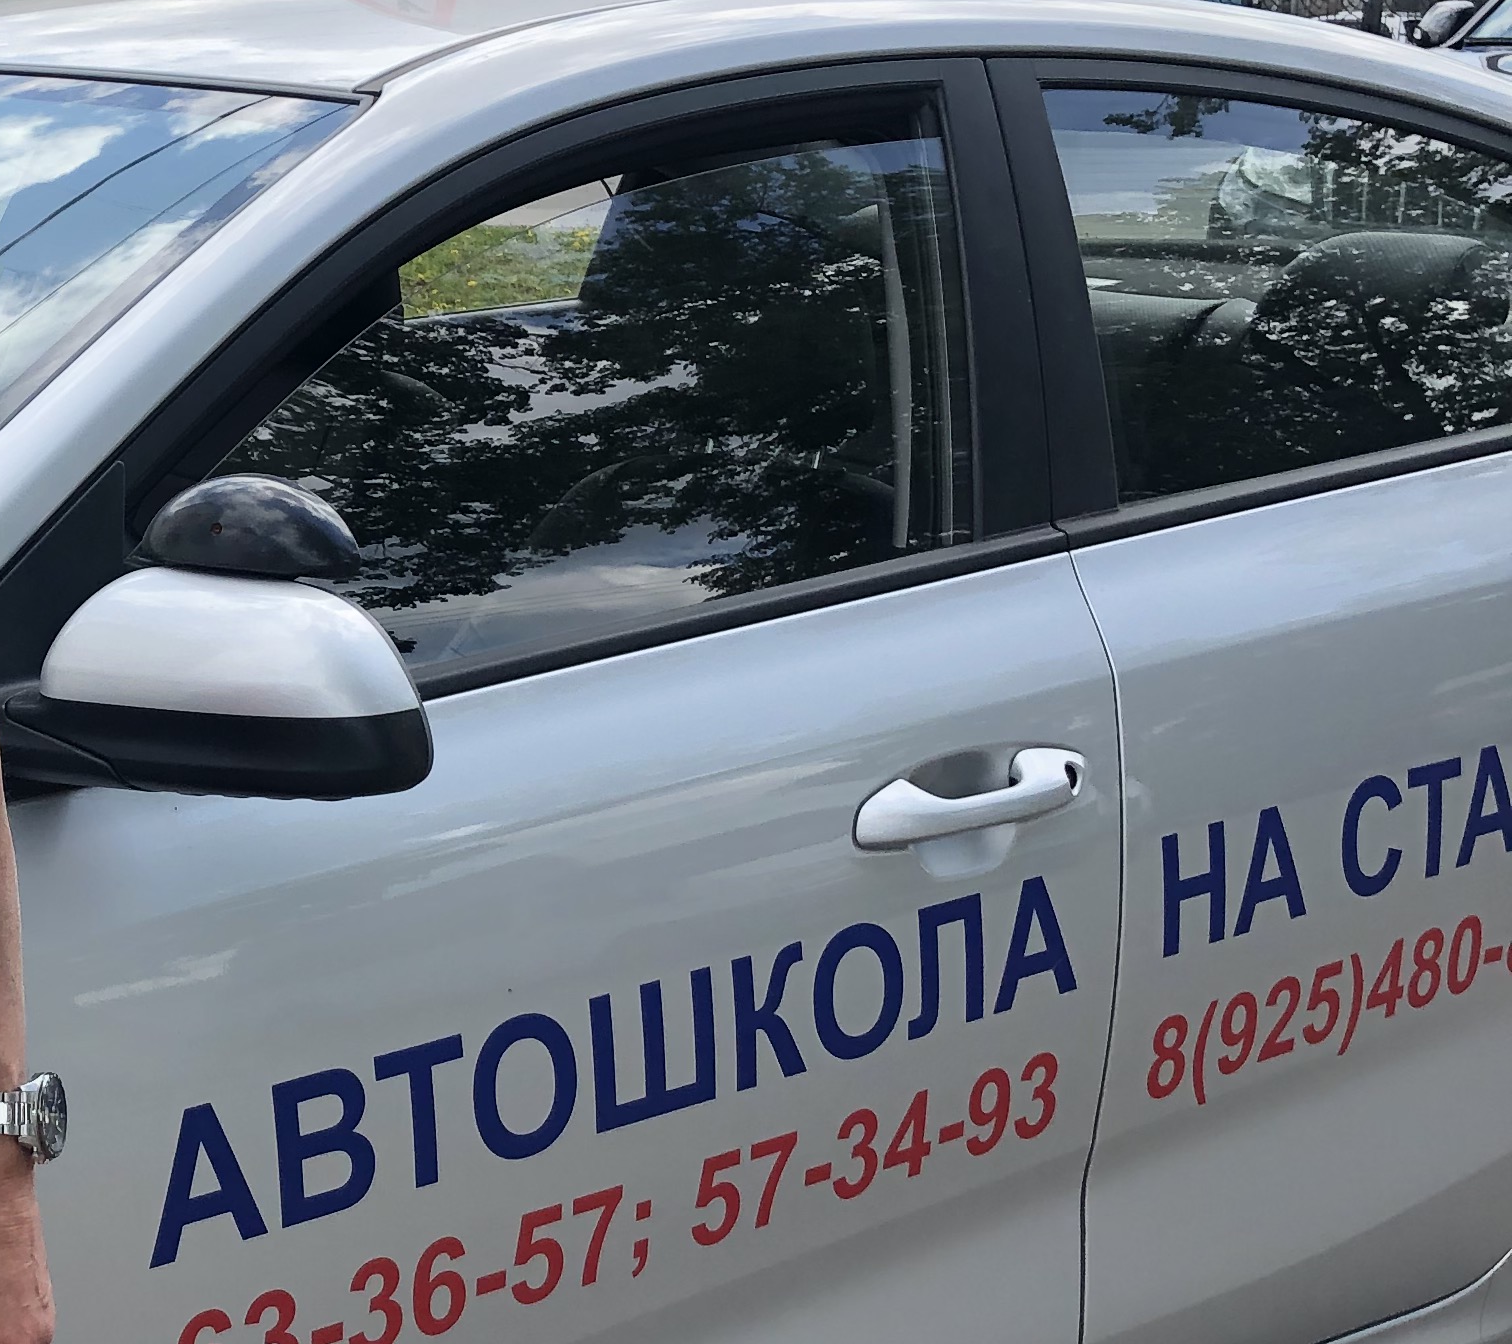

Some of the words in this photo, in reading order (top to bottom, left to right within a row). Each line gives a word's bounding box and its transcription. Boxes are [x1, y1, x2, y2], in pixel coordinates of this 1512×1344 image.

[149, 874, 1078, 1269] АВТОШКОЛА
[1161, 806, 1307, 958] НА
[1341, 744, 1512, 897] СТА
[691, 1052, 1059, 1246] 57-34-93
[1146, 914, 1512, 1105] 8(925)480-
